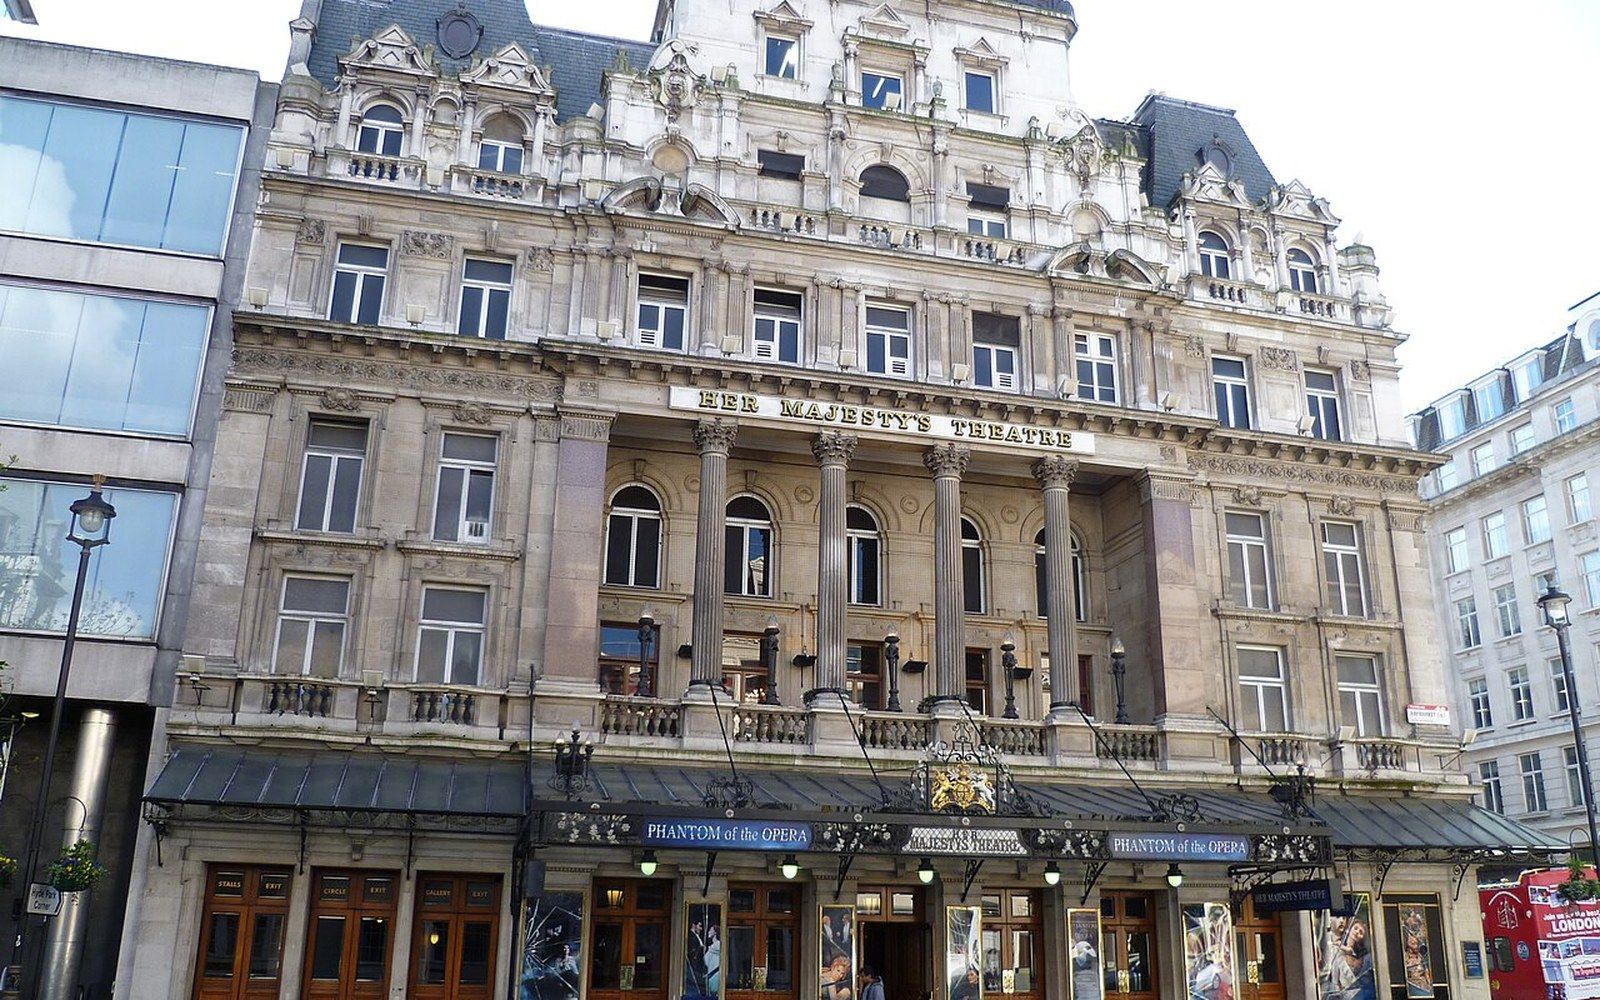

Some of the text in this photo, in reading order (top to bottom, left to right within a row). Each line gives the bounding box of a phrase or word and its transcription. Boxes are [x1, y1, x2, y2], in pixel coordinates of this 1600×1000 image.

[699, 390, 1073, 448] HER MAJESTY'S THEATRE
[647, 823, 808, 842] PHANTOM of the OPERA
[953, 829, 978, 839] HER
[972, 838, 1020, 853] THEATRE
[1114, 838, 1247, 854] PHANTOM of the OPERA
[218, 880, 241, 888] STALLS
[265, 882, 282, 890] EXIT
[46, 889, 57, 899] Park
[370, 886, 387, 894] EXIT
[472, 890, 488, 898] EXIT
[1299, 889, 1327, 900] THEATRE
[34, 900, 51, 910] Corner
[1551, 916, 1600, 933] LONDON
